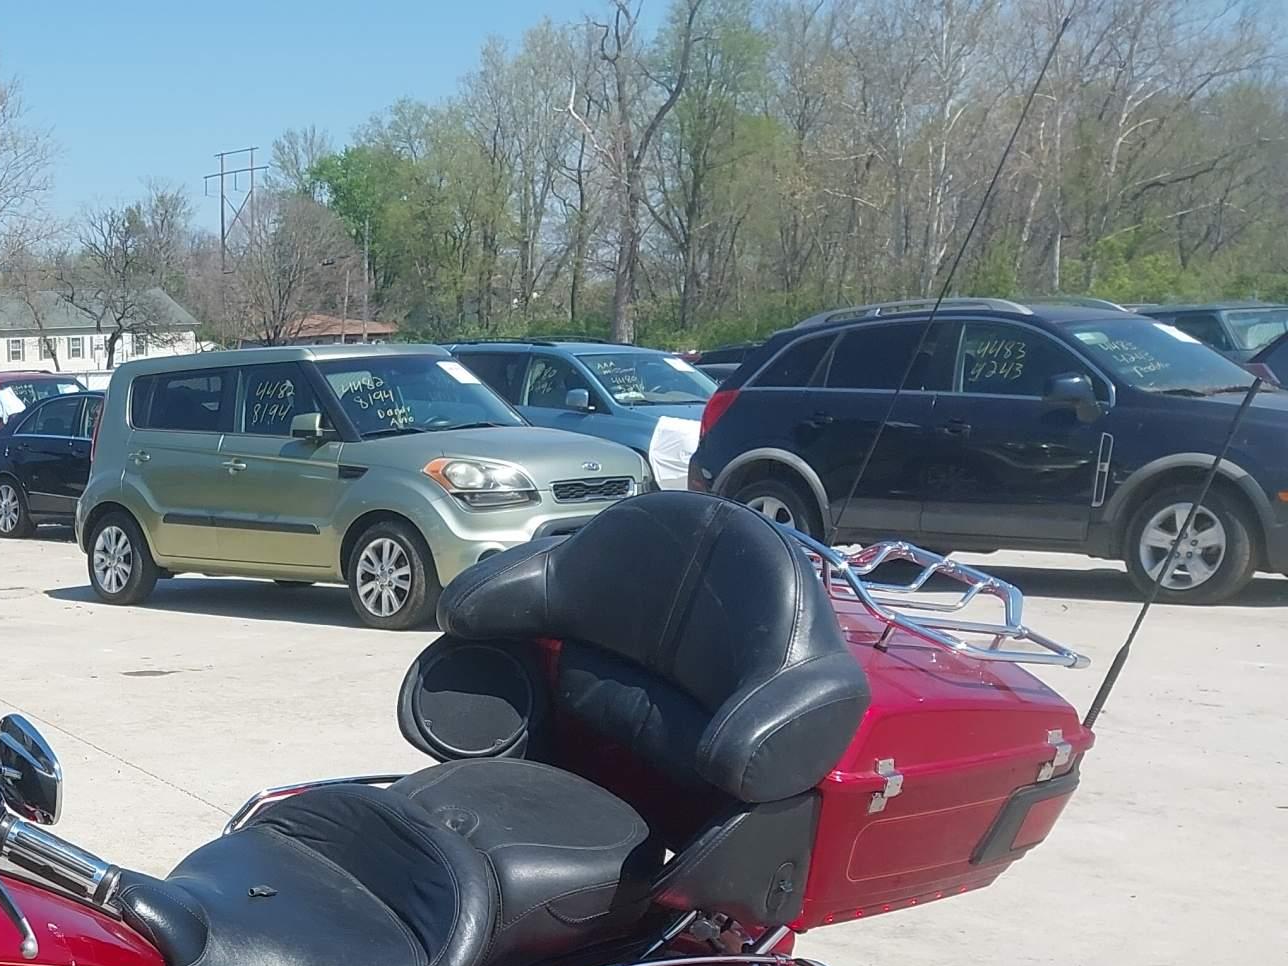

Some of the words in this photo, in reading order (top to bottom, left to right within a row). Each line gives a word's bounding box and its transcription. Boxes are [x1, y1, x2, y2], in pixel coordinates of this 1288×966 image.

[975, 340, 1026, 359] 4483
[255, 379, 296, 400] 4482
[340, 376, 385, 395] 4482
[353, 388, 395, 409] 8194
[252, 402, 292, 425] 8194
